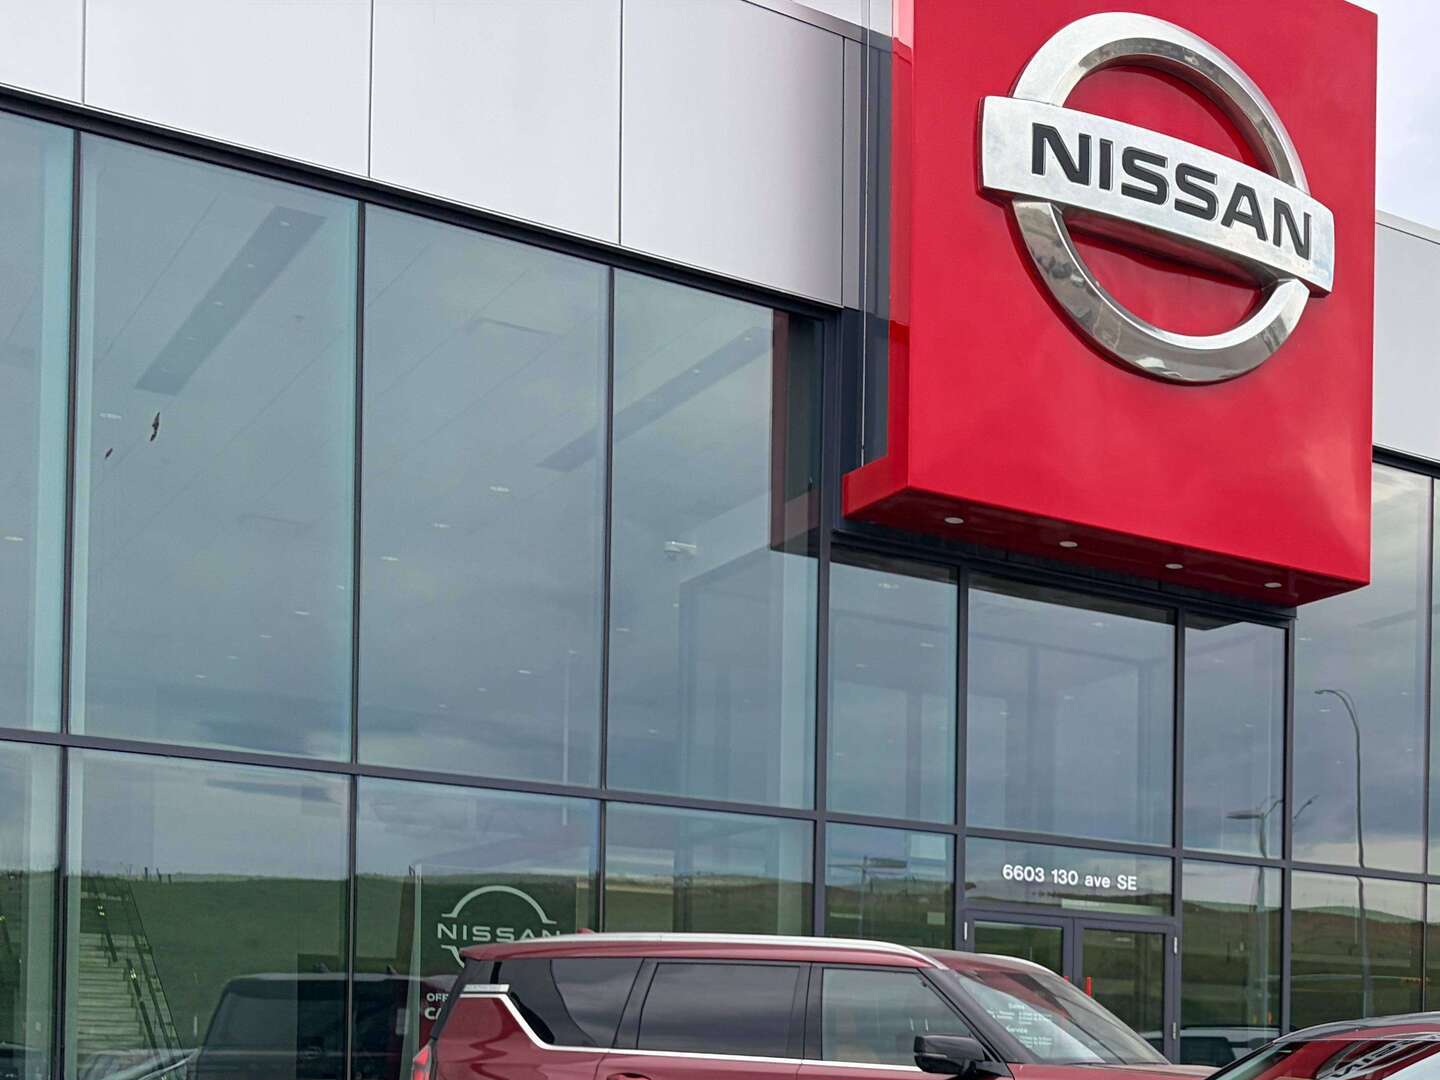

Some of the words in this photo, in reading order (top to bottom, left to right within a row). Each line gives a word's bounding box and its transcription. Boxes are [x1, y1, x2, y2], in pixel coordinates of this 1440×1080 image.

[1031, 122, 1311, 261] NISSAN
[1002, 864, 1045, 881] 6603
[1051, 868, 1079, 886] 130
[1084, 873, 1111, 889] ave
[1116, 875, 1137, 891] SE
